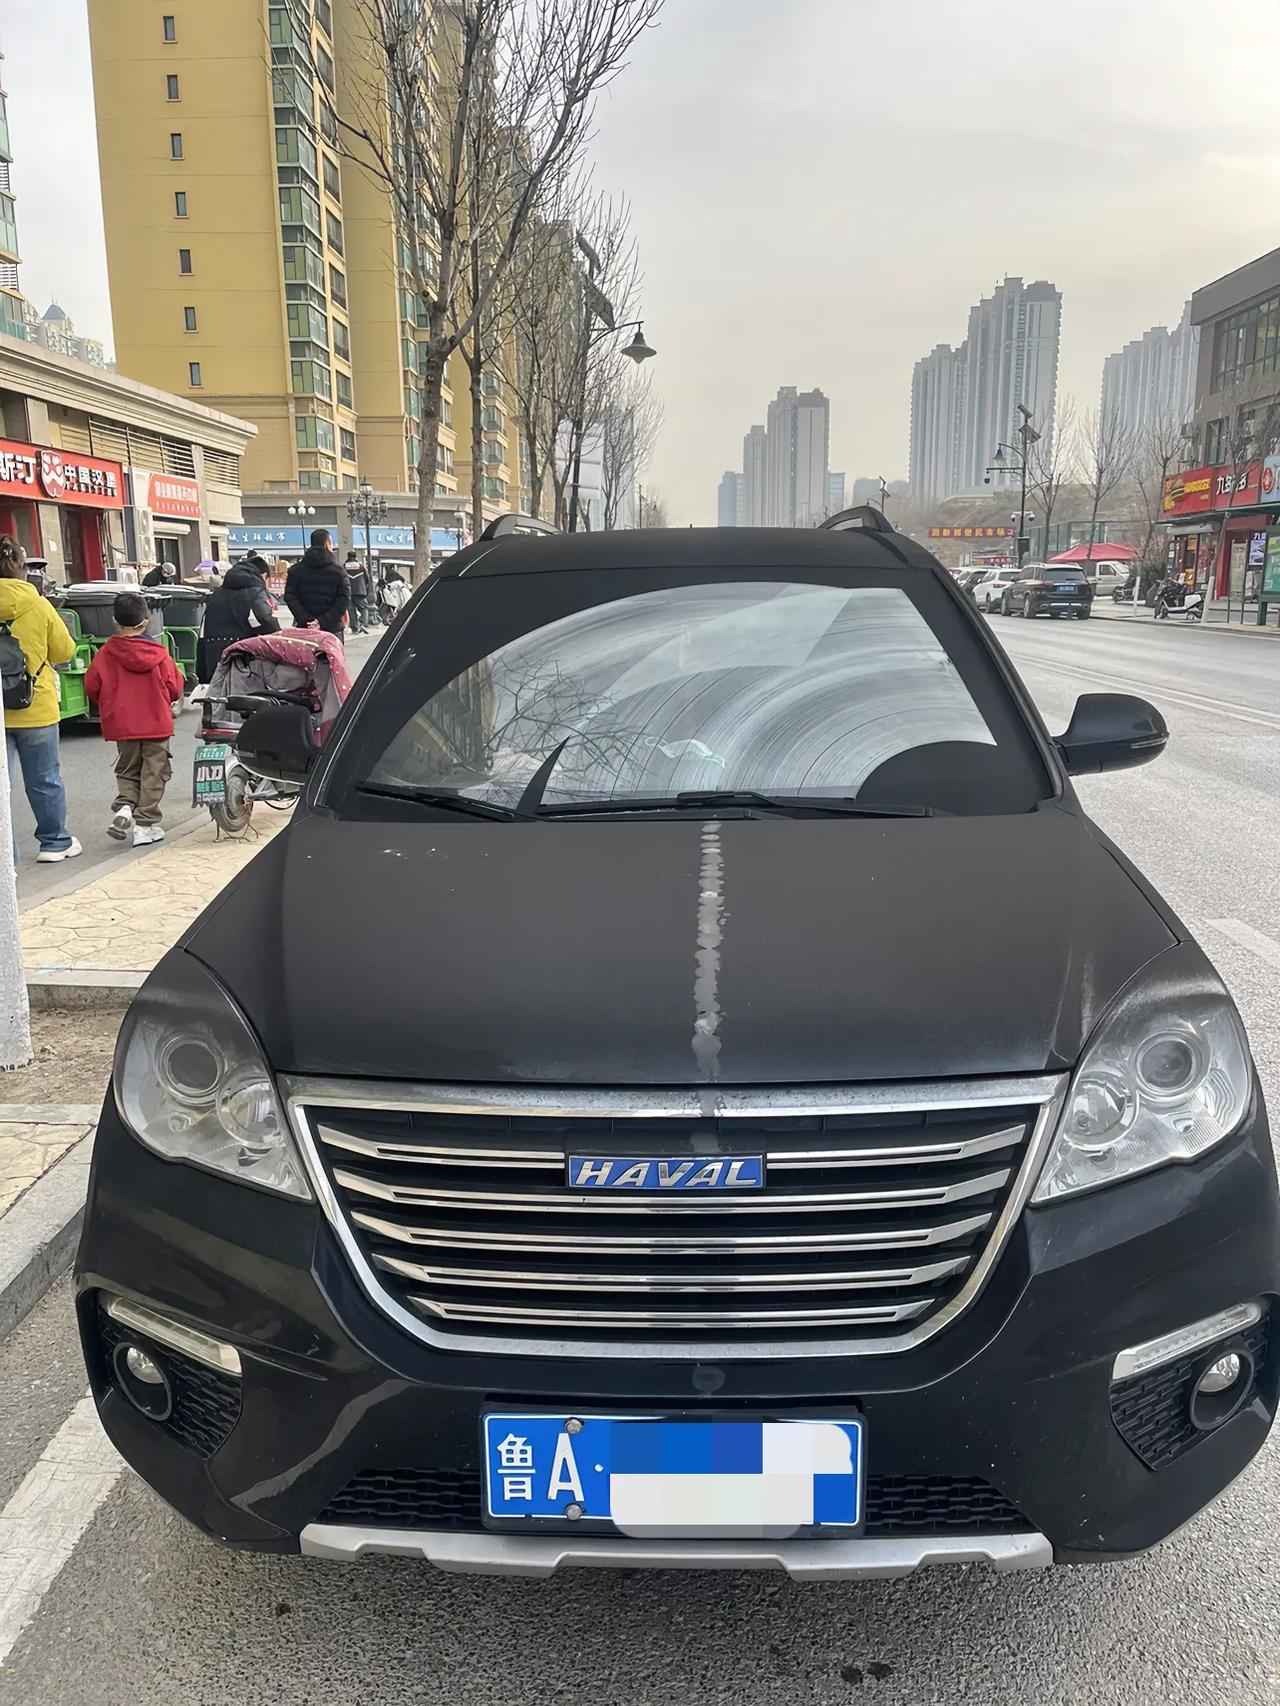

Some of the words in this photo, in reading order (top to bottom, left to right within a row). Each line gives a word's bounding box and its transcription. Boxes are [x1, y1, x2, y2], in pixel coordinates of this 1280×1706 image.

[1216, 472, 1248, 496] 九多多
[575, 1160, 757, 1188] HAVAL
